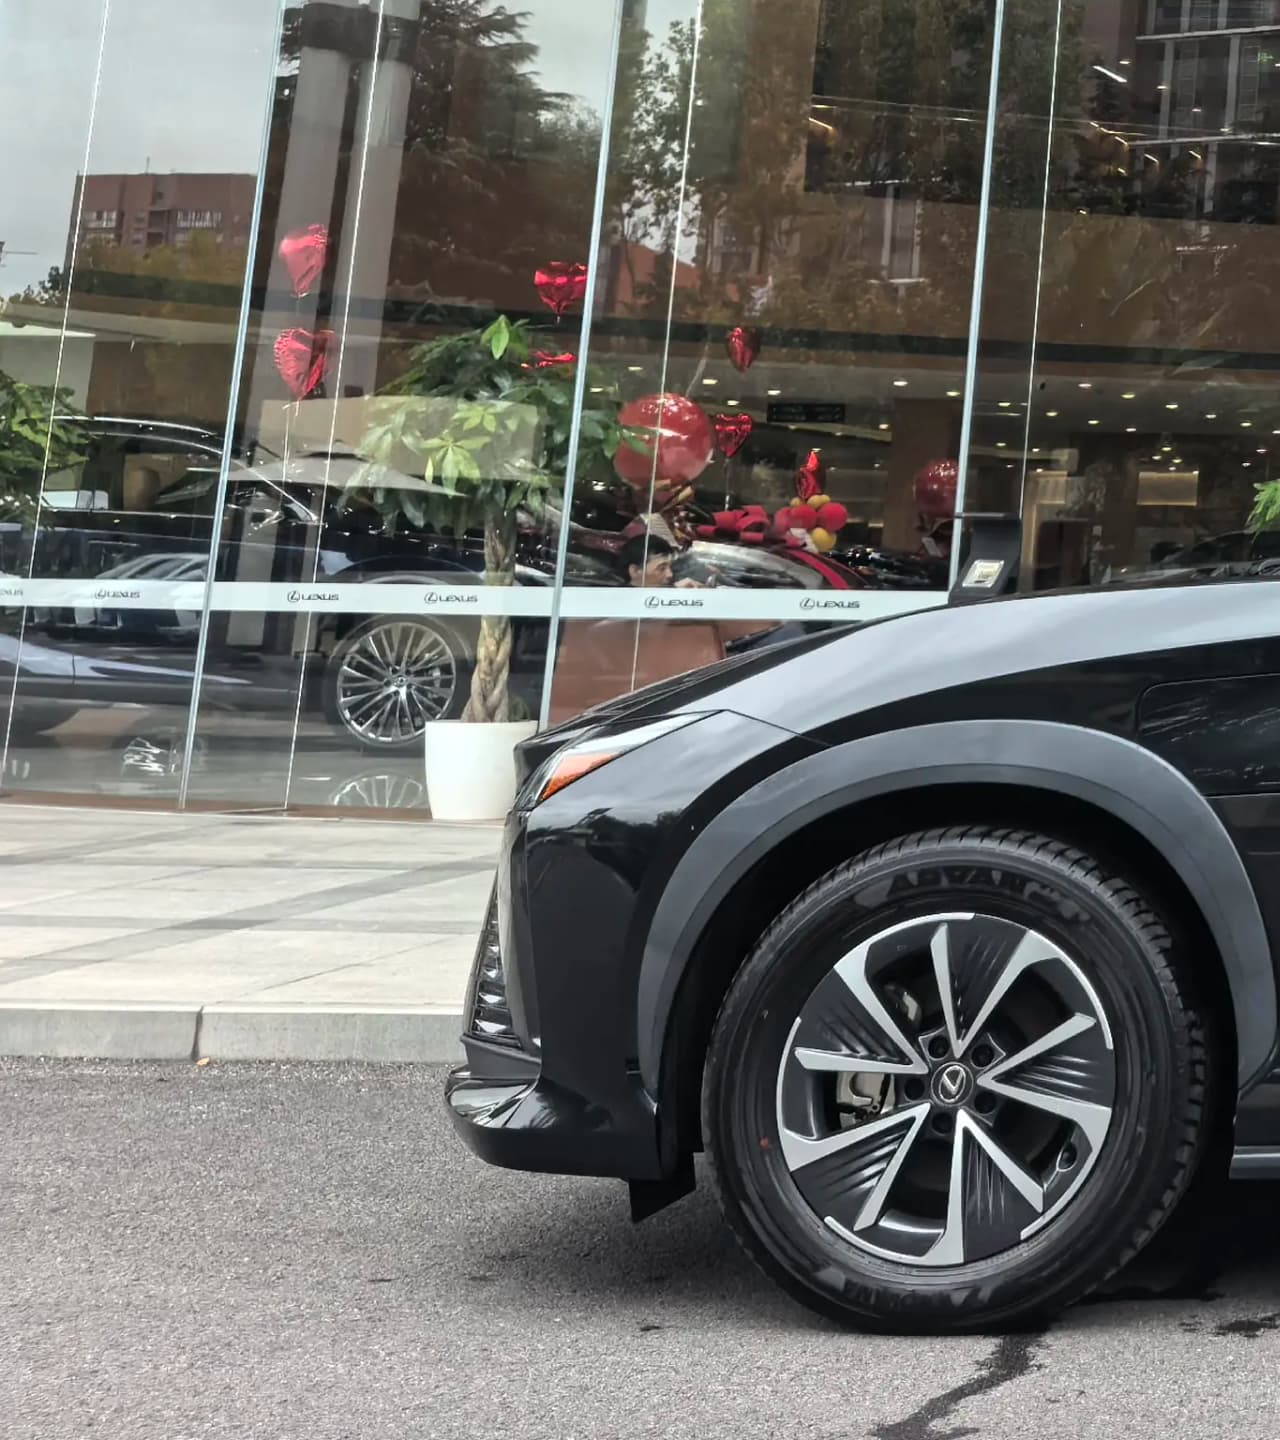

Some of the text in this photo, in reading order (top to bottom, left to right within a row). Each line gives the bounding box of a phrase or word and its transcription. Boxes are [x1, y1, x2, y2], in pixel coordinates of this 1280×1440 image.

[107, 591, 141, 599] LEXUS
[439, 594, 479, 603] LEXUS
[660, 599, 704, 607] LEXUS
[816, 601, 861, 609] LEXUS
